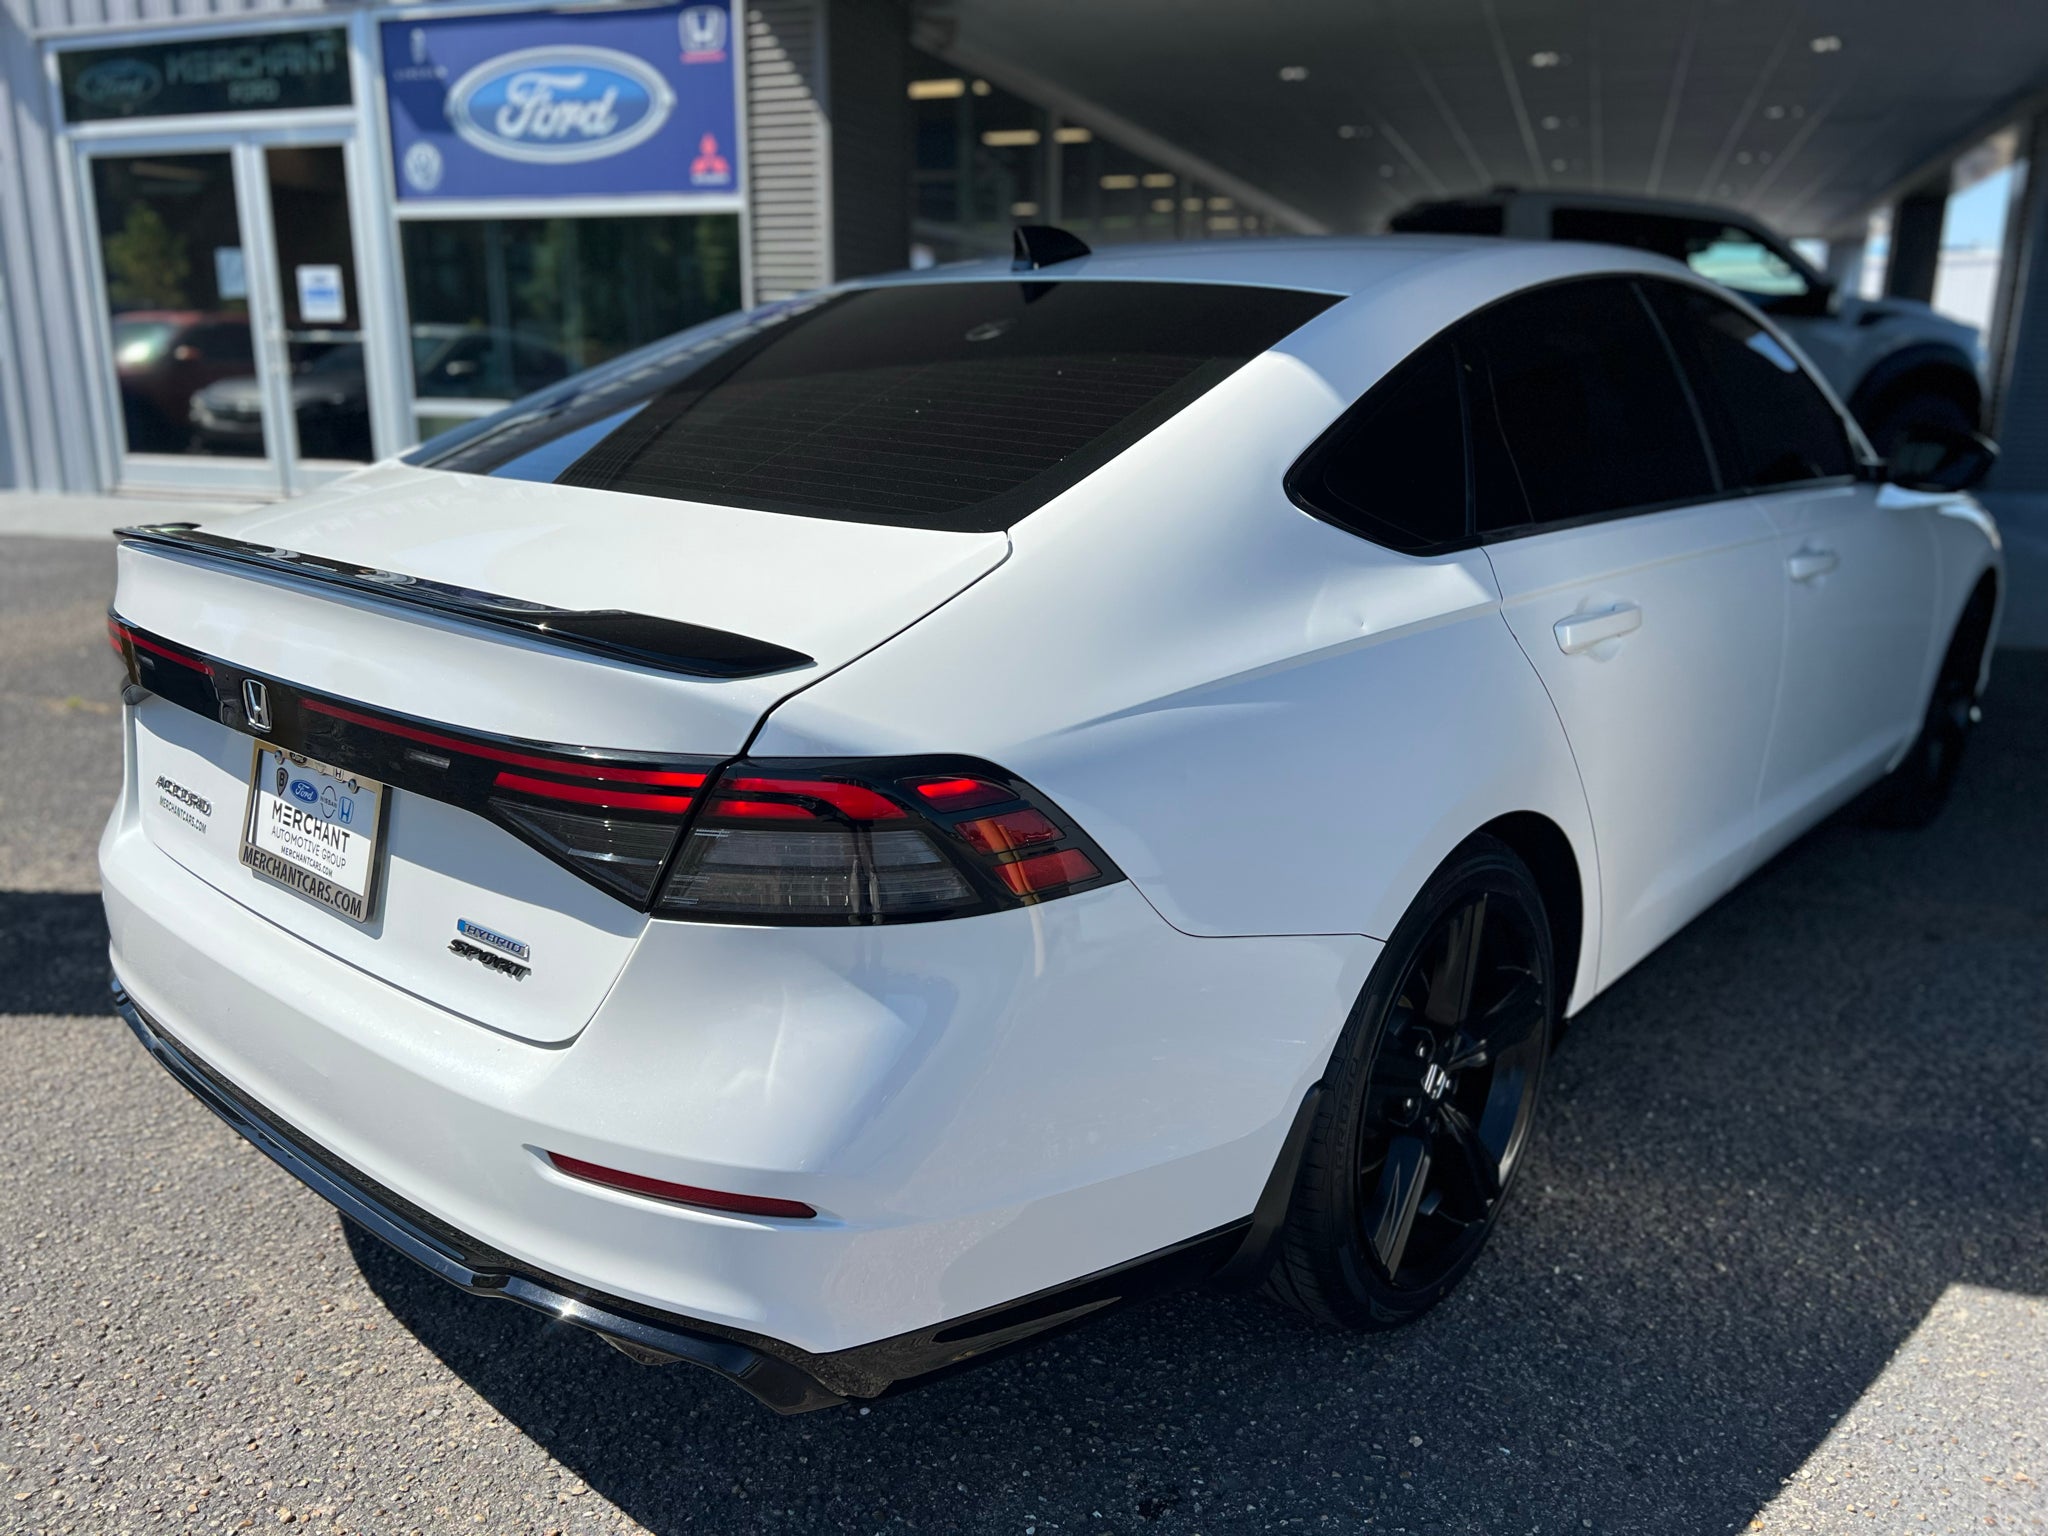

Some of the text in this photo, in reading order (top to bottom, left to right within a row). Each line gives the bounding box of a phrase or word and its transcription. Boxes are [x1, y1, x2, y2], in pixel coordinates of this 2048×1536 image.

[495, 70, 620, 138] Ford
[155, 775, 211, 817] ACCORD
[295, 783, 313, 800] Ford
[320, 796, 337, 808] NISSAN
[159, 795, 206, 834] MERCHANTCARS.COM
[272, 799, 350, 853] MERCHANT
[271, 826, 346, 869] AUTOMOTIVE GROUP
[280, 846, 333, 877] MERCHANTCARS.COM
[242, 846, 362, 918] MERCHANTCARS.COM
[467, 924, 521, 953] HYBRID
[447, 939, 532, 980] SPORT
